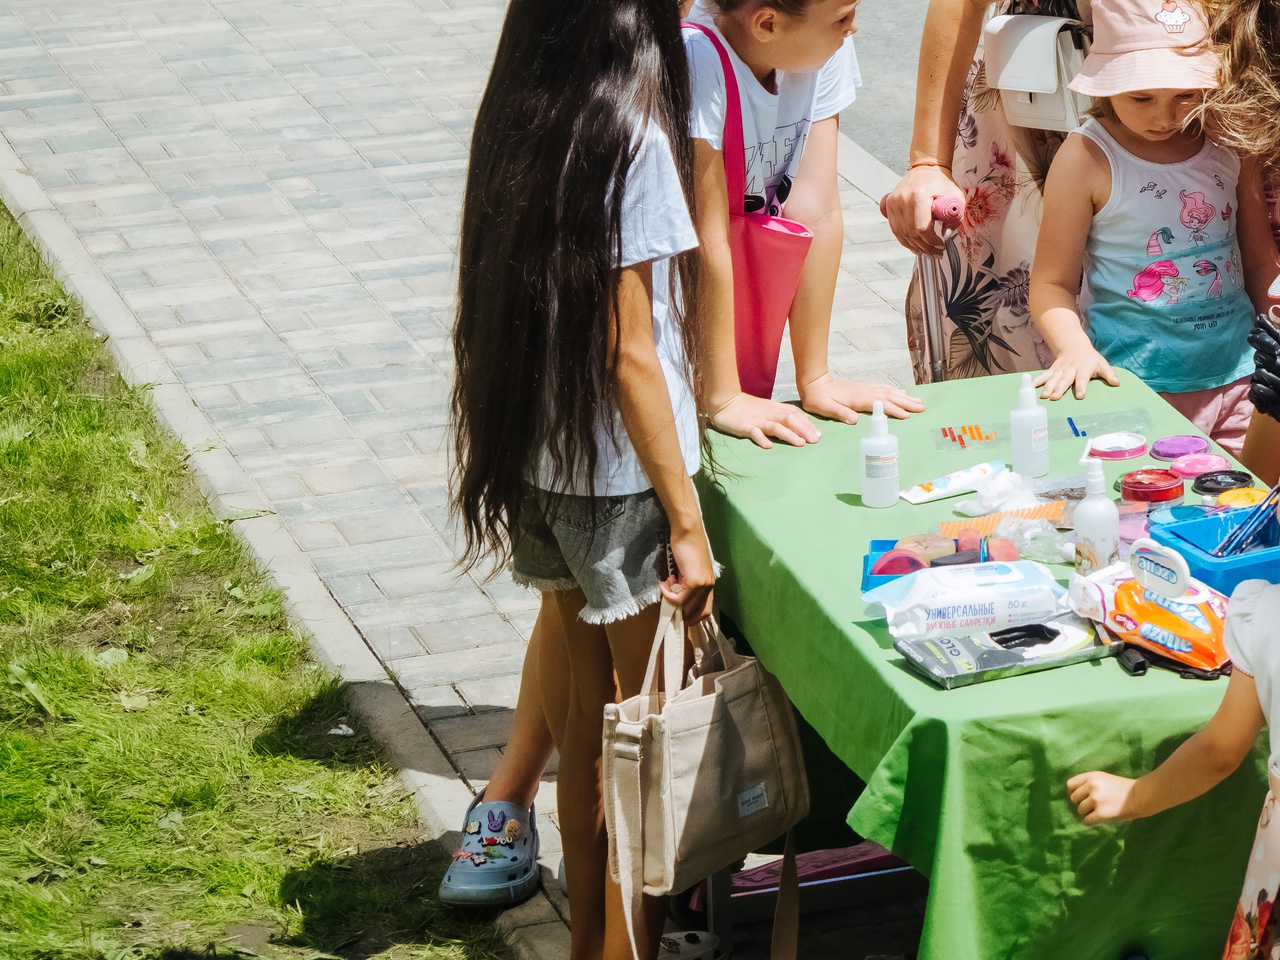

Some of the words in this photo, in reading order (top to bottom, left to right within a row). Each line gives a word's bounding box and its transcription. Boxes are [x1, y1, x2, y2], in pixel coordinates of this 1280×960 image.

[925, 602, 995, 620] УНИВЕРСАЛЬНЫЕ
[1008, 600, 1020, 609] 80
[925, 620, 957, 631] ВЛАЖНЫЕ
[960, 616, 996, 628] САЛФЕТКИ
[939, 638, 961, 657] GLO
